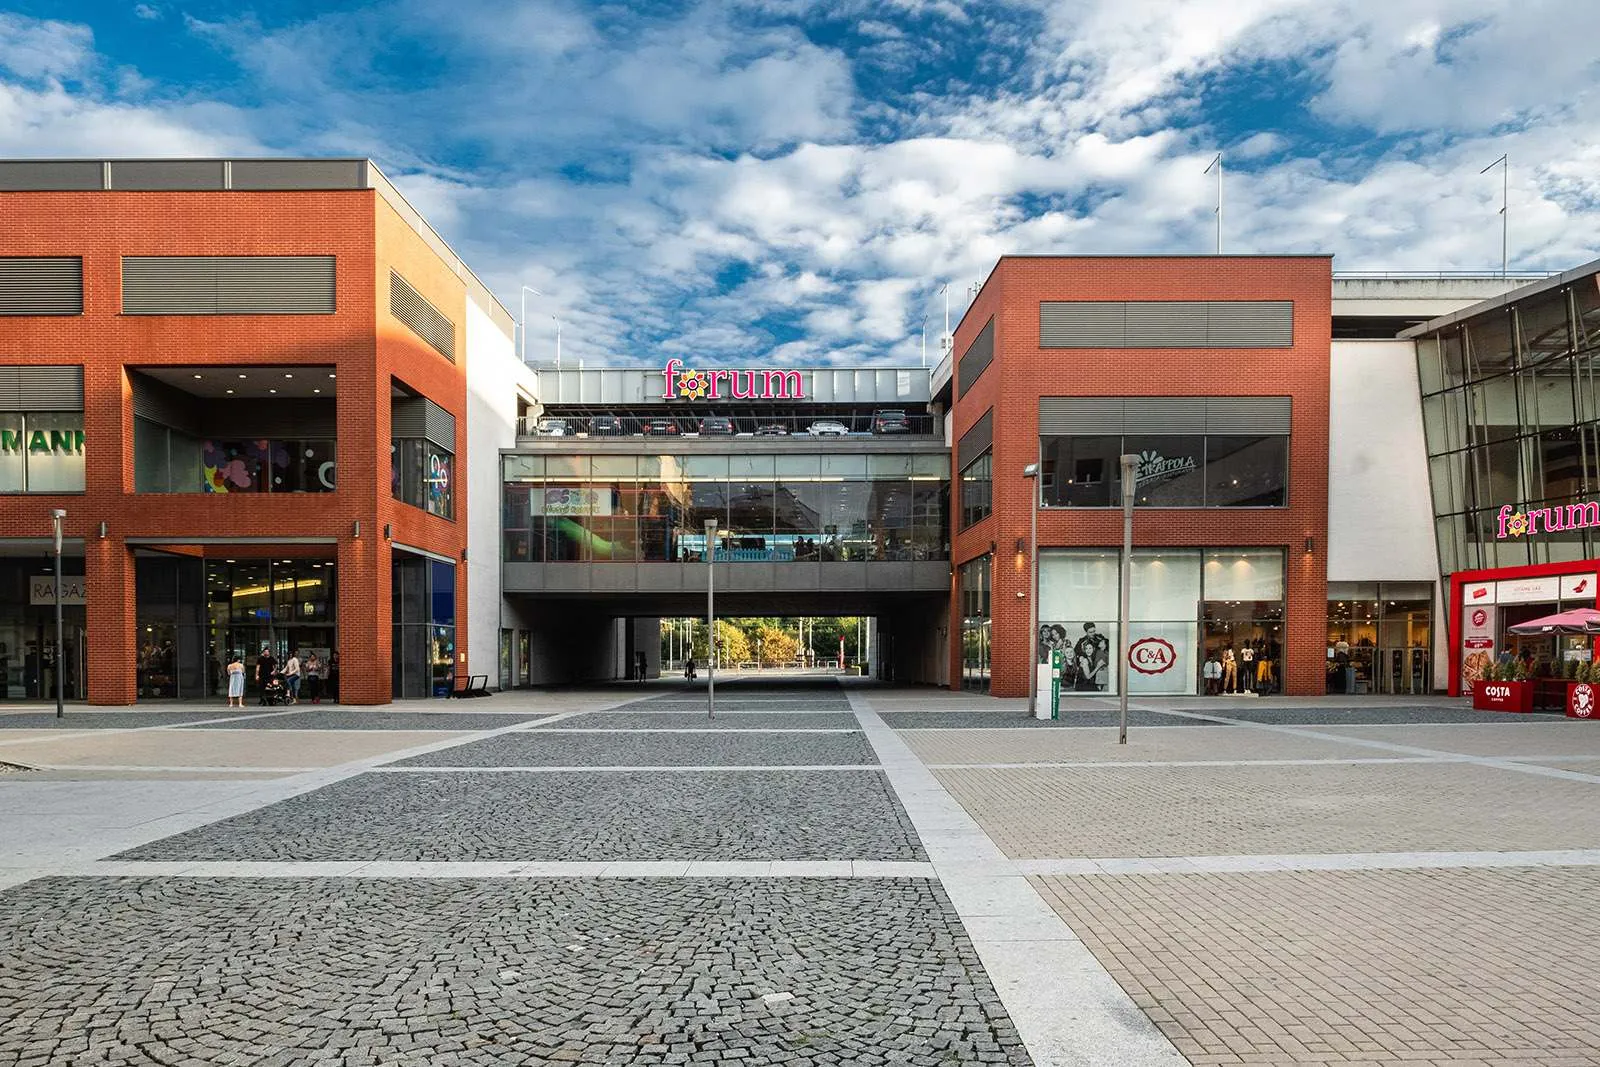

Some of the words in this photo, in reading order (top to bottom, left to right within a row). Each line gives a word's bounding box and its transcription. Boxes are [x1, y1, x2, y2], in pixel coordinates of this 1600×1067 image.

[662, 359, 805, 400] forum
[1497, 501, 1600, 538] forum
[1136, 647, 1168, 664] C&A
[1485, 686, 1511, 698] COSTA
